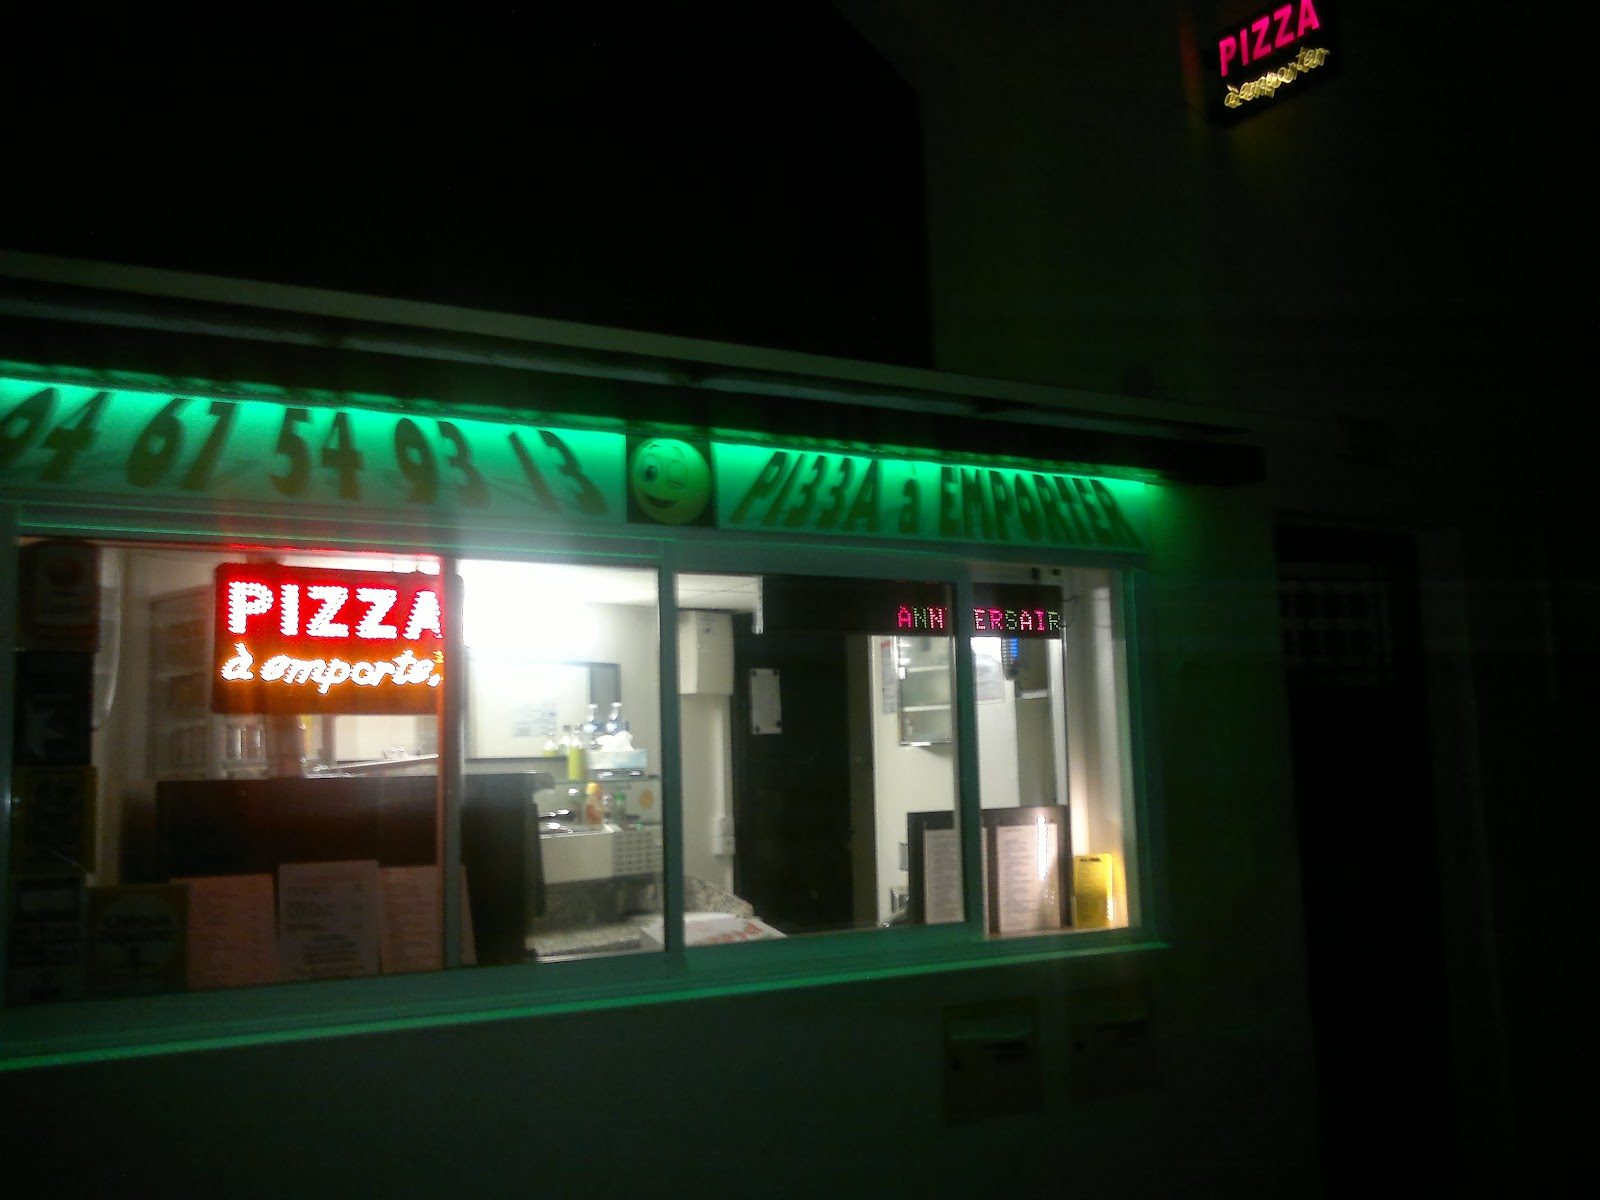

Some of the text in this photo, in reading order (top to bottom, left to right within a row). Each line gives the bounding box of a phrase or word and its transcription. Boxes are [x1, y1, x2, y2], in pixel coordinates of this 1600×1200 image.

[1218, 0, 1320, 78] PIZZA
[126, 397, 237, 490] 67
[268, 407, 361, 499] 54
[396, 417, 489, 507] 93
[939, 466, 1143, 549] EMPORTER
[226, 580, 443, 640] PIZZA
